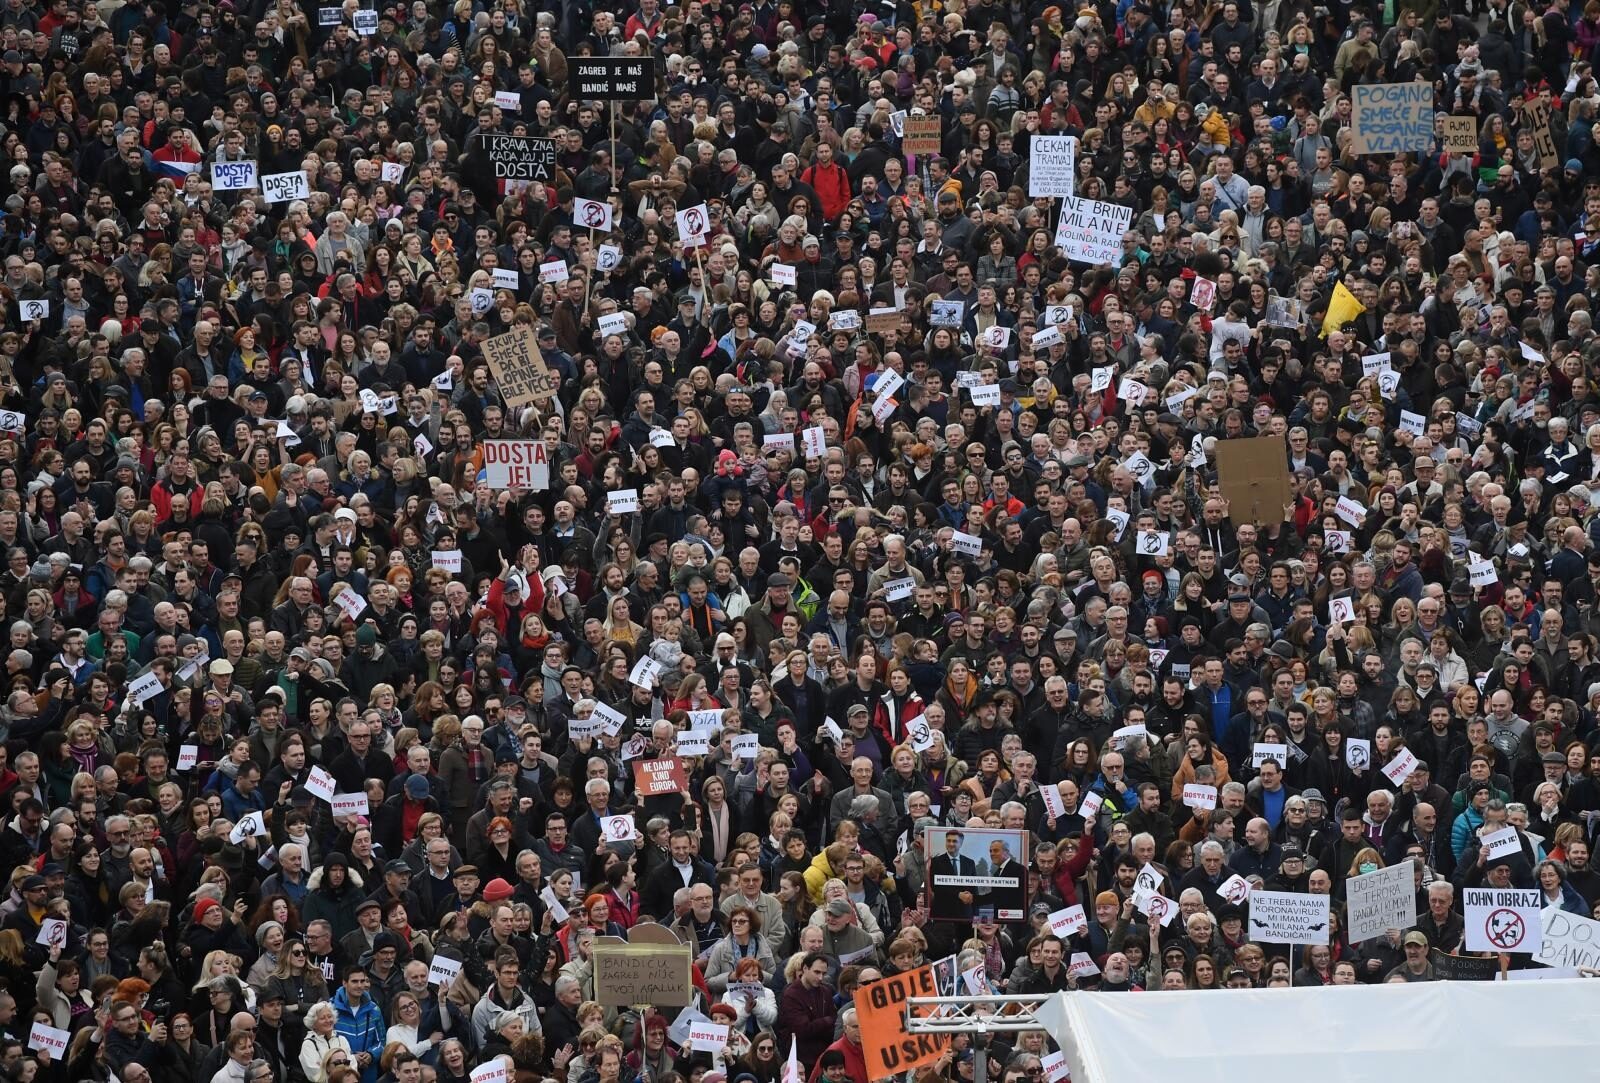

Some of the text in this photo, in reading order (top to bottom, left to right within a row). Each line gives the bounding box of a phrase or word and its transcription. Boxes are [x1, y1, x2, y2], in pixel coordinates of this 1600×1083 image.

[578, 64, 642, 76] ZAGREB JE NAŠ
[581, 80, 637, 93] BANDIĆ MARŠ
[1357, 87, 1434, 106] POGANO
[1417, 109, 1435, 121] IZ
[1358, 124, 1434, 138] POGANE
[1450, 121, 1470, 132] AJMO
[492, 137, 530, 152] KRAVA
[533, 139, 555, 152] ZNA
[1035, 138, 1071, 154] ČEKAM
[1367, 134, 1433, 152] VLAKE!
[489, 151, 555, 165] KADA JOJ JE
[1036, 154, 1071, 166] TRAMVAJ
[215, 162, 253, 180] DOSTA
[495, 162, 549, 179] DOSTA
[229, 173, 248, 188] JE!
[266, 175, 304, 192] DOSTA
[276, 185, 300, 200] JE!
[1063, 197, 1132, 222] NE BRINI
[1060, 211, 1125, 236] MILANE
[1059, 228, 1100, 246] KOLINDA
[488, 330, 529, 353] SKUPLJE
[500, 353, 531, 373] DA BI
[496, 364, 539, 389] LOPINE
[502, 379, 527, 401] BILE
[1170, 401, 1184, 410] DOST
[484, 442, 547, 465] DOSTA
[506, 465, 533, 488] JE!
[642, 759, 675, 773] NE DAMO
[652, 770, 670, 783] KINO
[649, 779, 678, 793] EUROPA
[1184, 791, 1206, 800] DOSTA
[333, 799, 356, 809] DOSTA
[1353, 867, 1407, 894] DOSTA JE
[1363, 883, 1401, 904] TERORA
[1466, 891, 1540, 907] JOHN OBRAZ
[1253, 896, 1325, 908] NE TREBA NAMA
[1255, 906, 1320, 917] KORONAVIRUS
[1267, 914, 1310, 924] MI IMAMO
[1051, 918, 1074, 929] DOSTA
[1272, 922, 1305, 931] MILANA
[432, 965, 452, 977] DOSTA
[871, 970, 932, 1009] GDJE
[32, 1032, 55, 1046] DOSTA
[692, 1031, 727, 1042] DOSTA JE!
